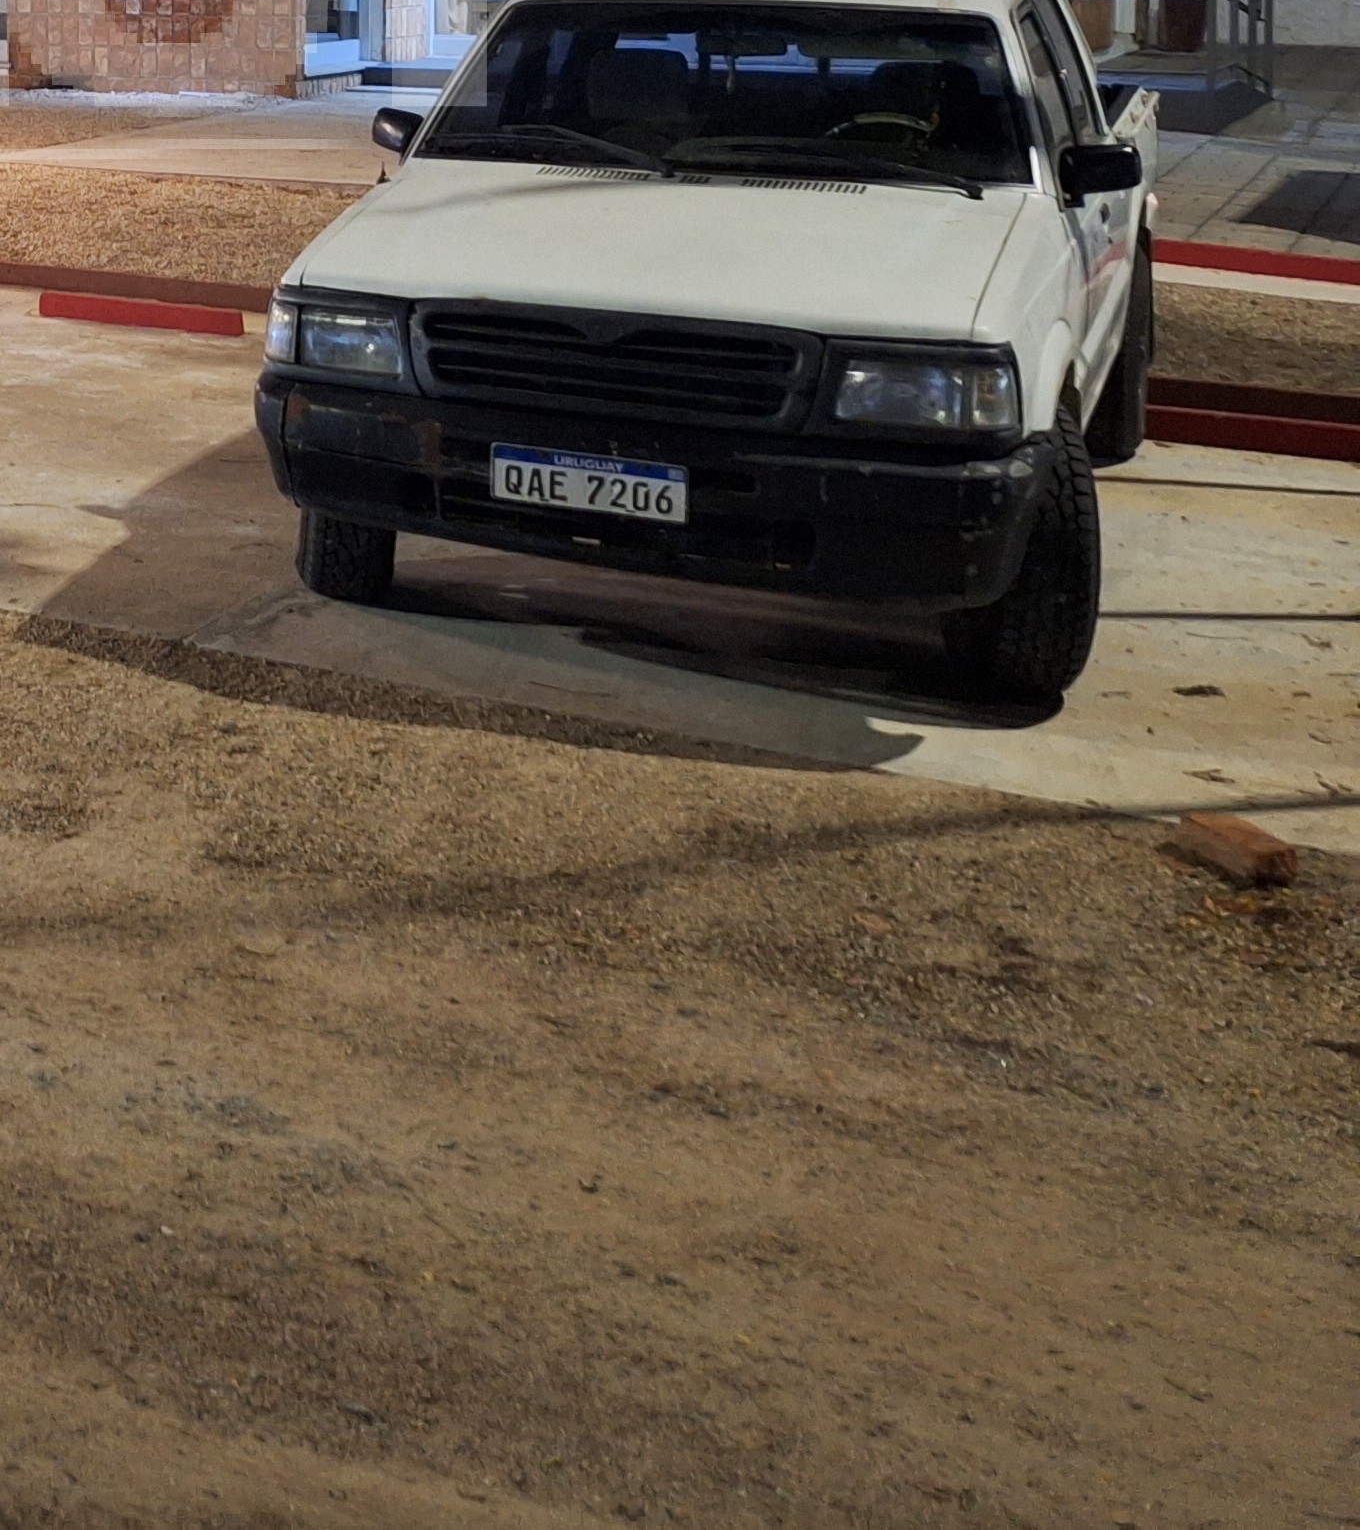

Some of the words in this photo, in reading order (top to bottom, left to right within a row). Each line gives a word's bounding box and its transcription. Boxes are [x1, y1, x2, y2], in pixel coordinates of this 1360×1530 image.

[553, 454, 625, 473] URUGUAY
[504, 464, 568, 502] QAE
[587, 474, 674, 515] 7206
